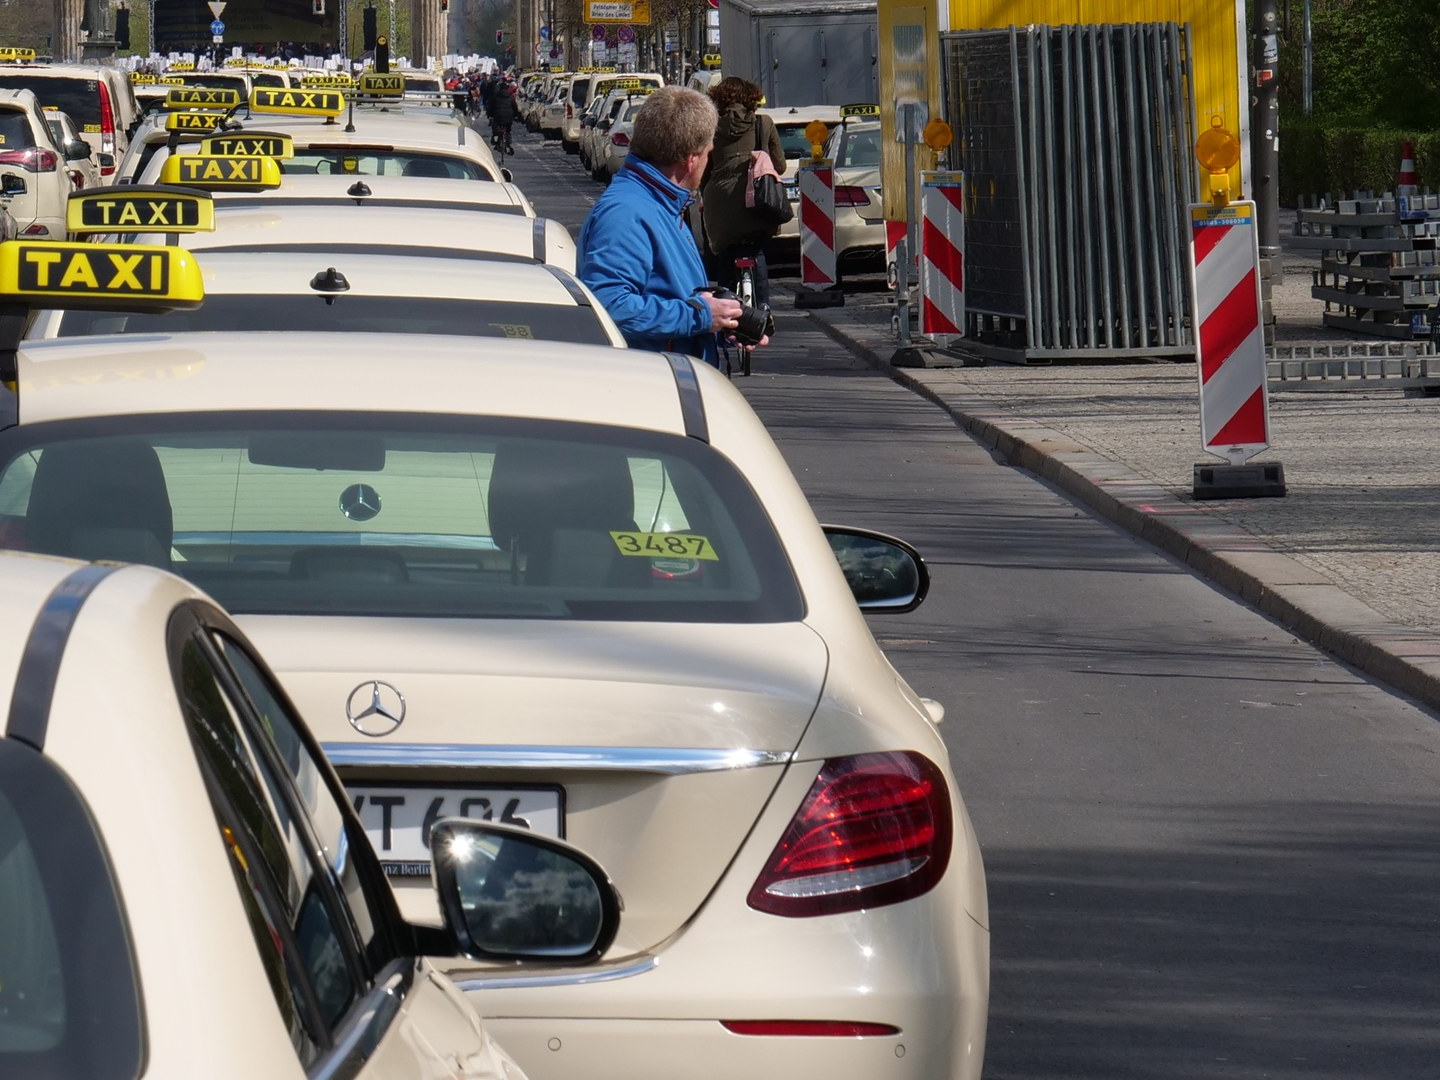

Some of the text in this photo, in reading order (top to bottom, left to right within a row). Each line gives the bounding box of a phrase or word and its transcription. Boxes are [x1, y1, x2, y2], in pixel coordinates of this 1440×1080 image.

[369, 78, 398, 89] TAXI
[179, 92, 226, 102] TAXI
[265, 92, 328, 108] TAXI
[848, 107, 872, 115] TAXI
[220, 139, 274, 155] TAXI
[183, 159, 260, 180] TAXI
[96, 201, 183, 225] TAXI
[26, 251, 162, 290] TAXI
[616, 535, 707, 556] 3487
